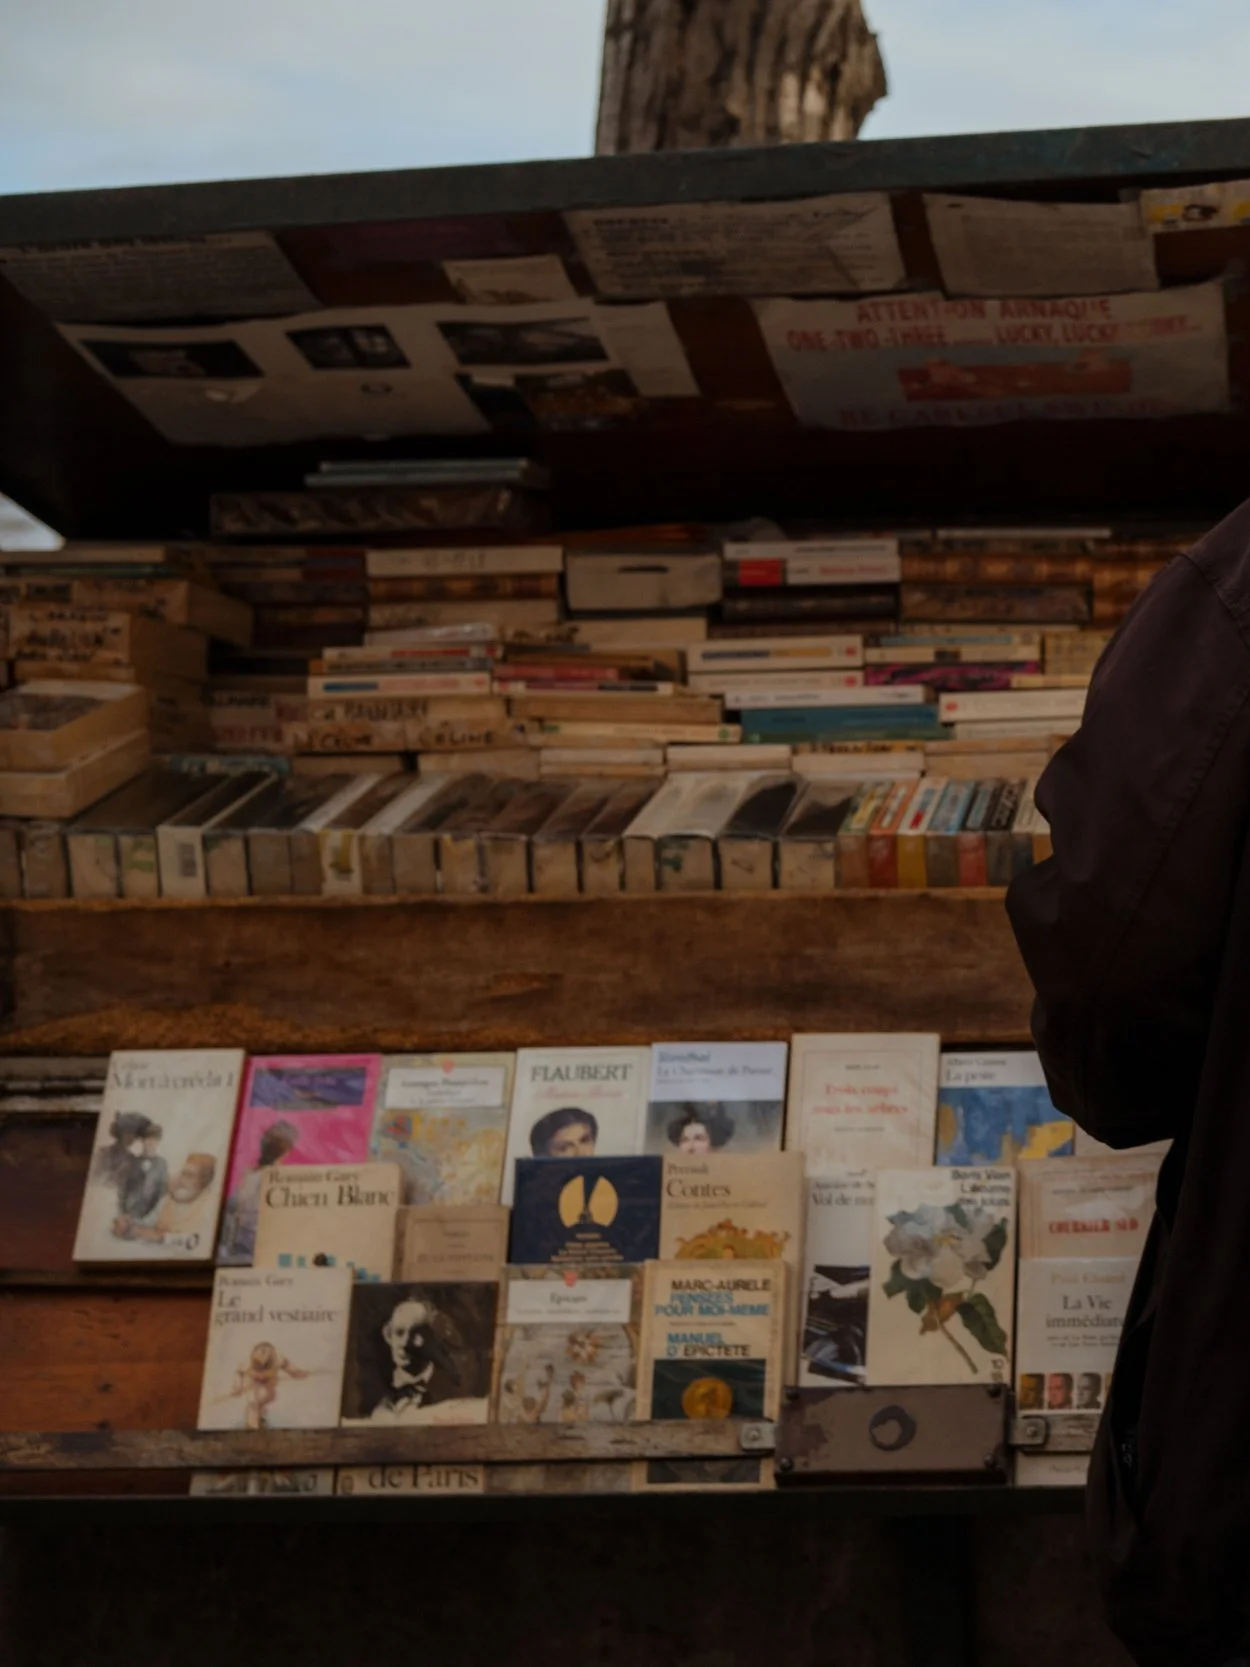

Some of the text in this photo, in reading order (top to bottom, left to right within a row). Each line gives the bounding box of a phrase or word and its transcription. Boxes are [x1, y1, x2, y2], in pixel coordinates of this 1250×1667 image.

[531, 1062, 635, 1082] FLAUBERT
[946, 1069, 962, 1081] La
[265, 1184, 395, 1209] Chien Blanc
[666, 1178, 731, 1198] Contes
[812, 1193, 833, 1206] Vol
[218, 1290, 242, 1308] Le
[1062, 1294, 1112, 1310] La Vie
[214, 1304, 339, 1326] grand vestiaire
[667, 1332, 723, 1344] MANUEL
[367, 1464, 404, 1489] de
